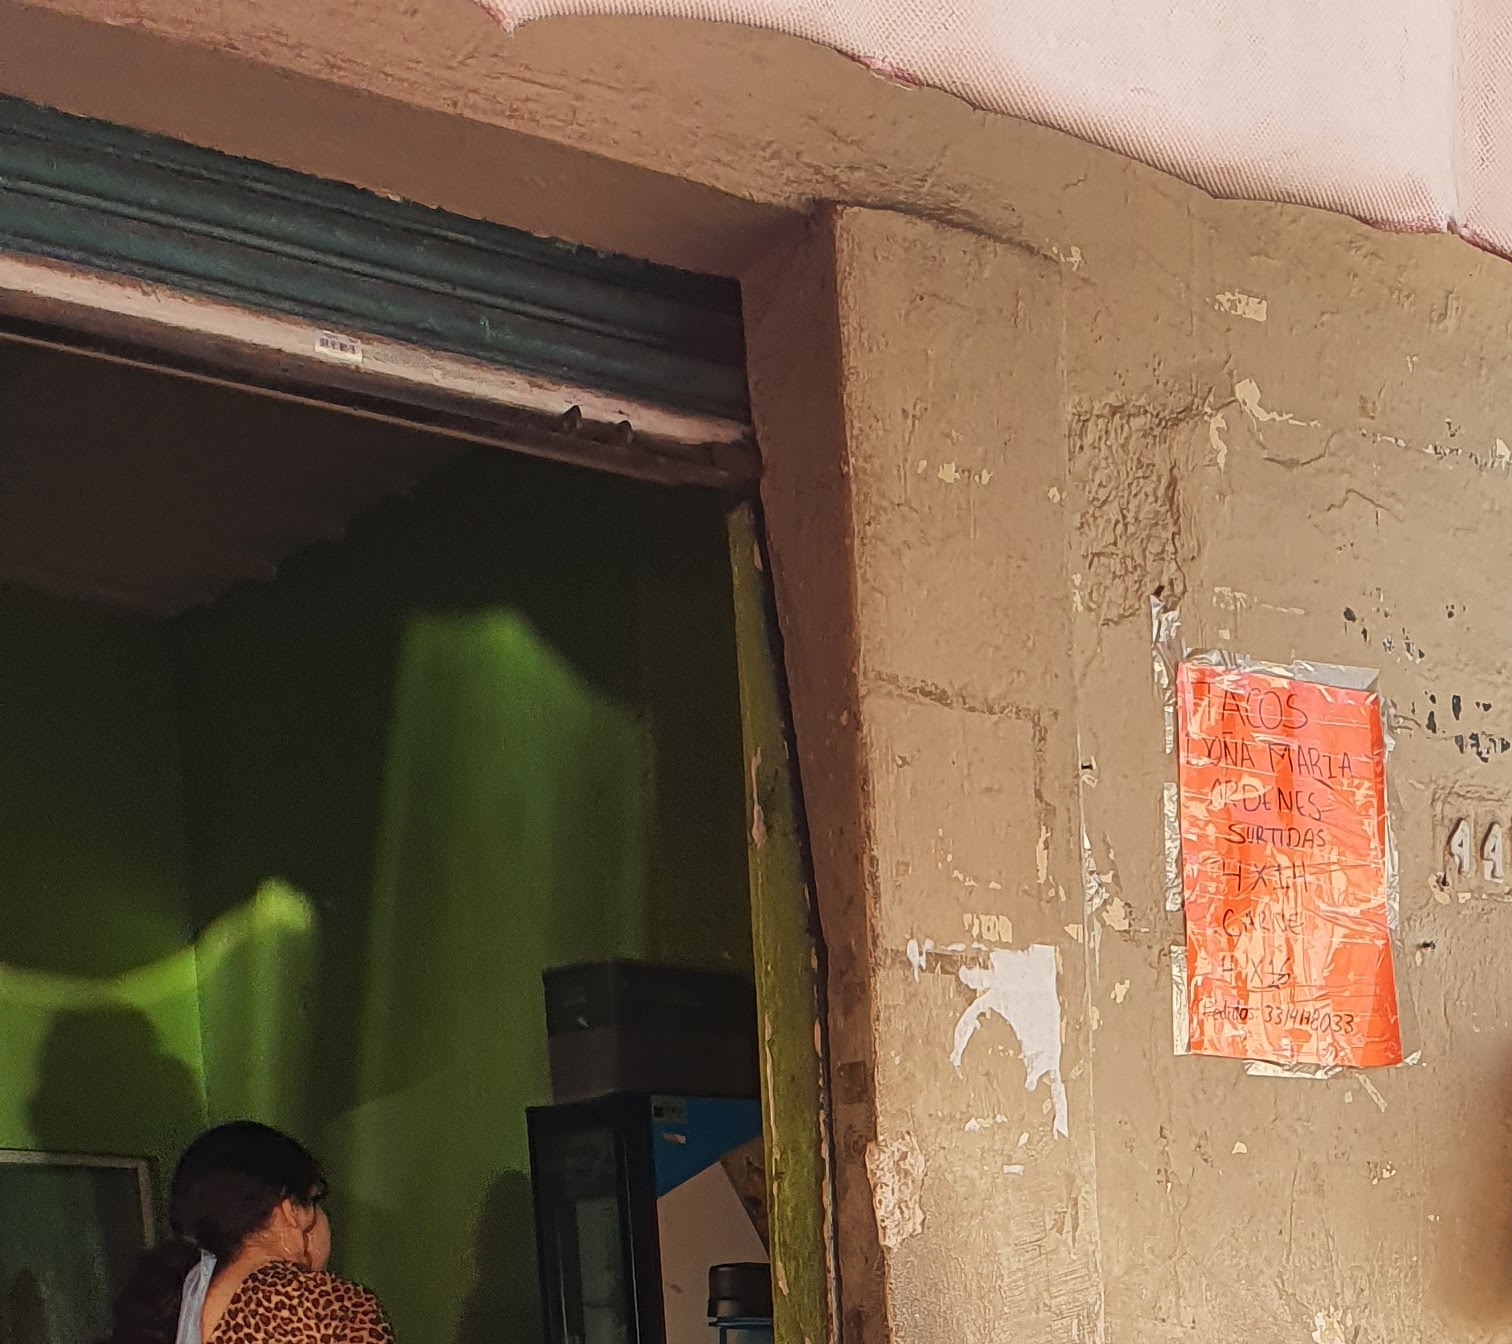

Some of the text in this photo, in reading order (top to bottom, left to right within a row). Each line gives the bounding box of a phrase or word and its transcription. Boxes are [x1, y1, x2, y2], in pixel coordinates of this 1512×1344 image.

[1190, 681, 1309, 730] TACOS
[1267, 741, 1354, 780] MARIA
[1224, 822, 1328, 850] SURTIDAS
